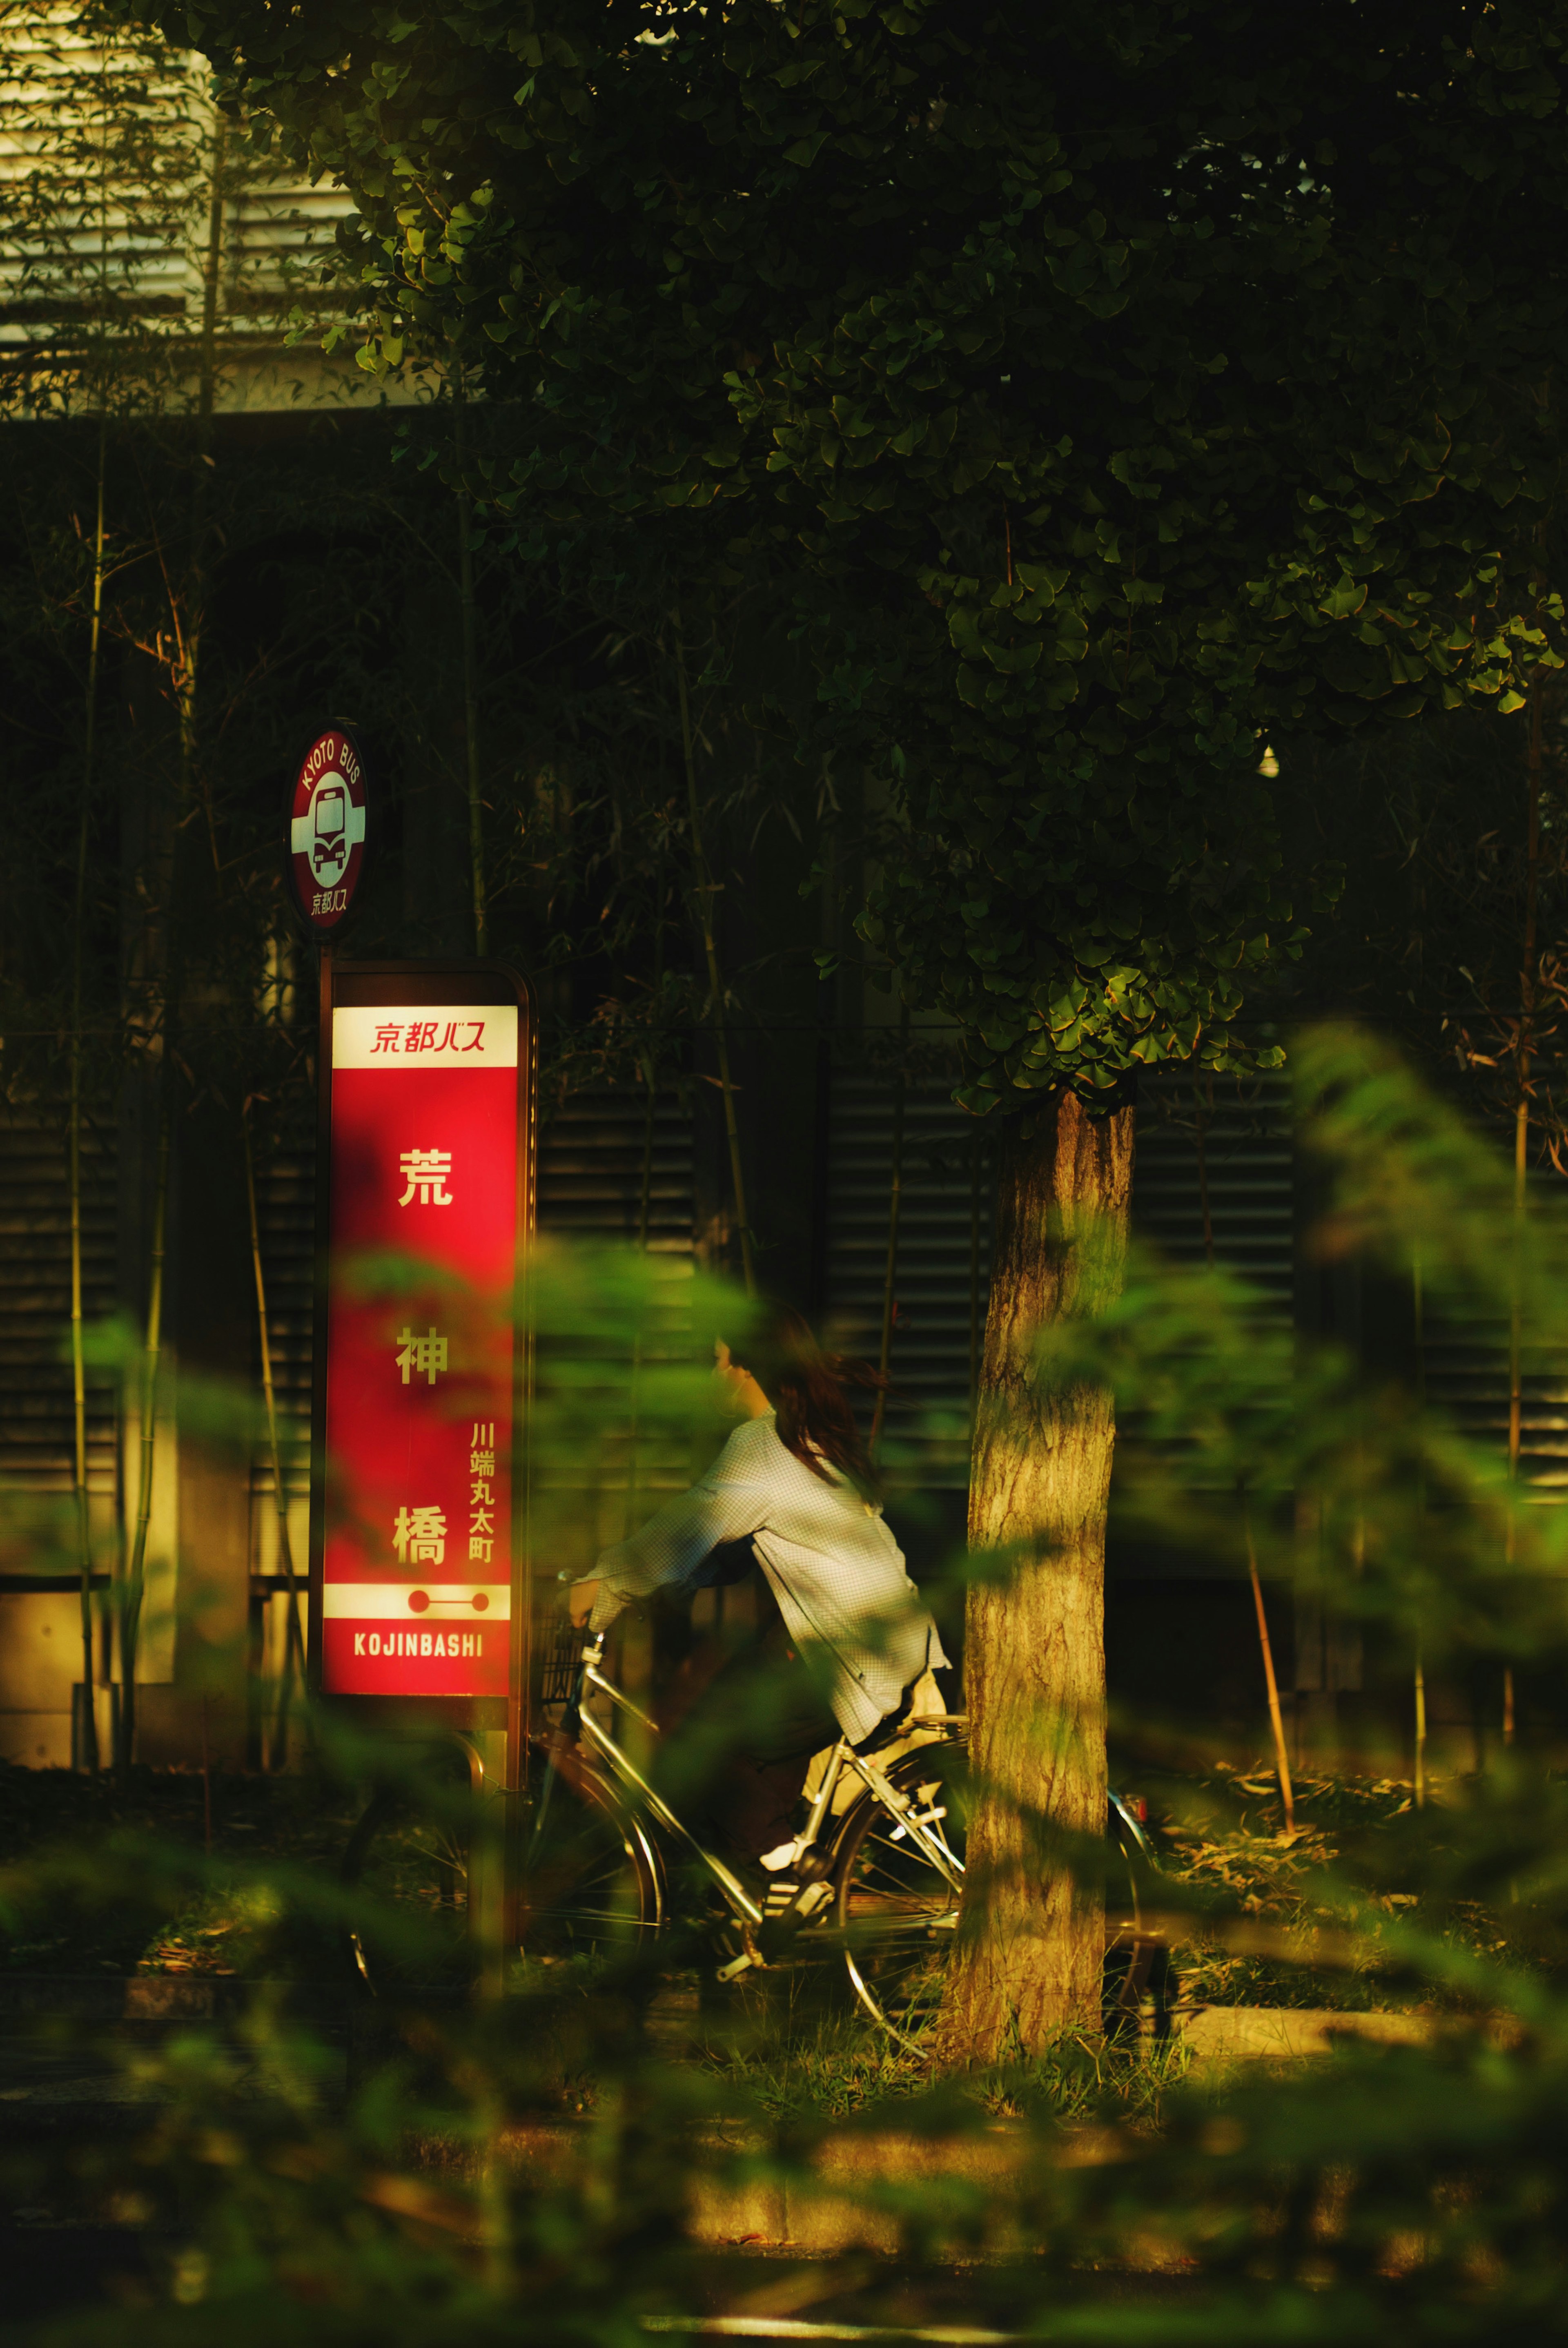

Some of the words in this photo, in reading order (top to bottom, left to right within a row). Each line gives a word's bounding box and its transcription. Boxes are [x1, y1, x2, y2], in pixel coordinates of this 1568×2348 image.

[302, 738, 334, 790] KYOTO
[339, 743, 360, 784] BUS
[311, 889, 346, 916] 京都バス
[370, 1022, 485, 1052] 京都バス
[392, 1149, 453, 1565] 荒神橋
[469, 1423, 494, 1563] 川端丸太町
[354, 1633, 482, 1657] KOJINBASHI
